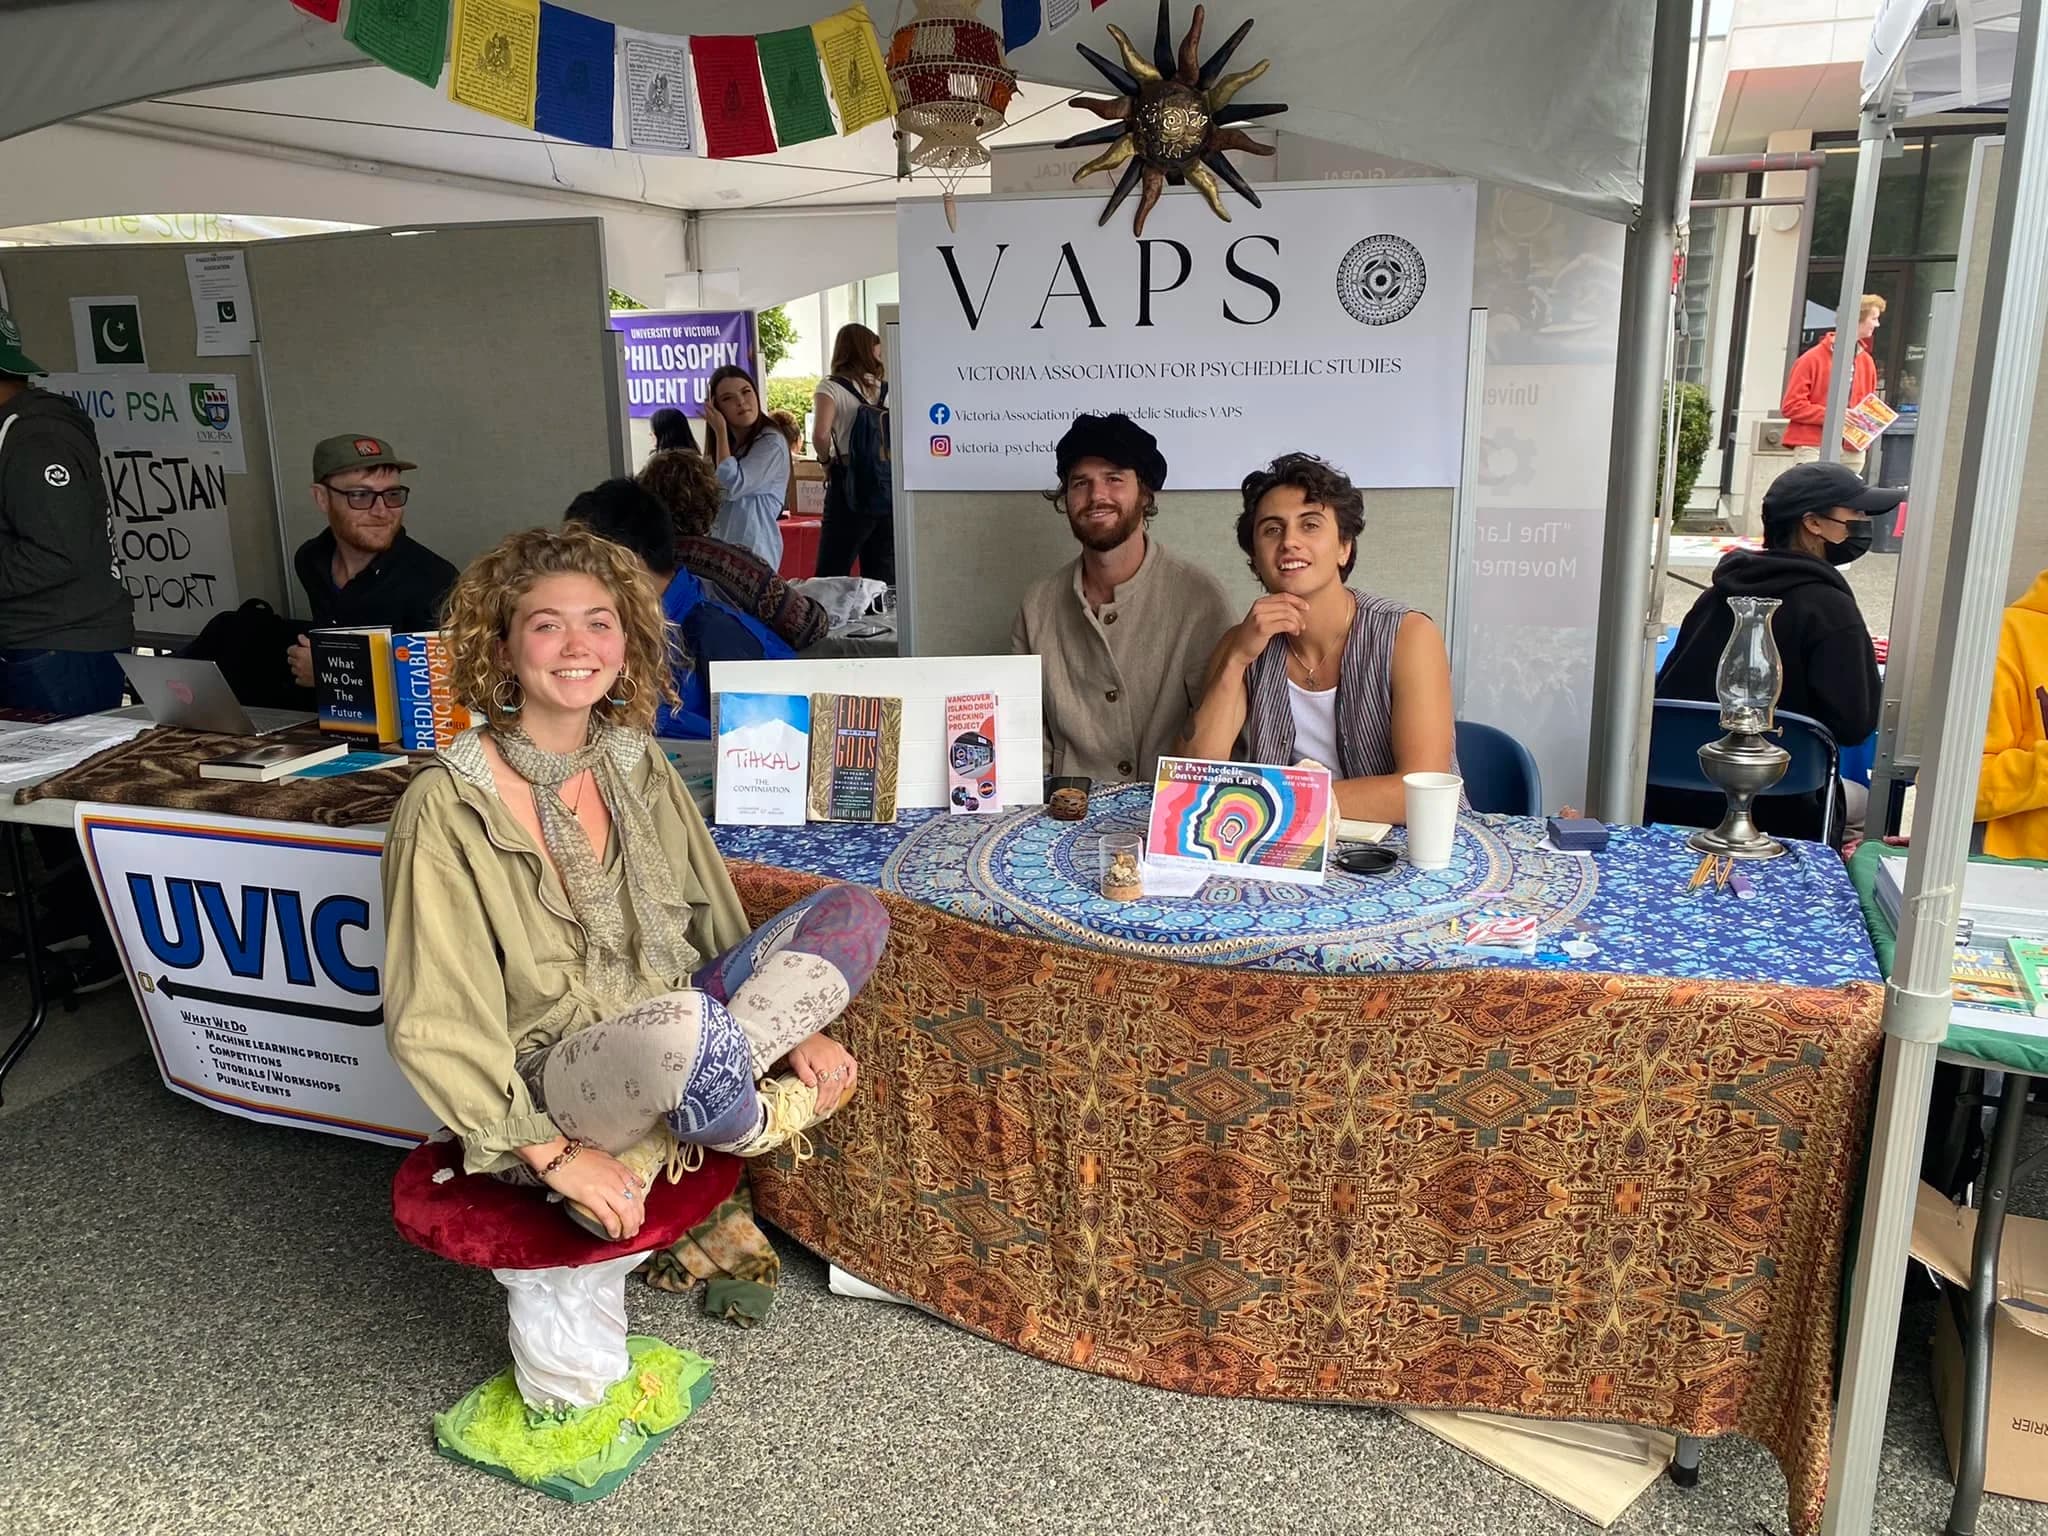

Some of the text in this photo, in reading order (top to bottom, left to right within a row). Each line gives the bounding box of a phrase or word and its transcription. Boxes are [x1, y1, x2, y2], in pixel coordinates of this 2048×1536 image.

[936, 235, 1281, 330] VAPS
[630, 325, 721, 339] UNIVERSITY OF VICTORIA
[957, 357, 1402, 383] VICTORIA ASSOCIATION FOR PSYCHEDELIC STUDIES
[126, 392, 179, 422] PSA
[955, 409, 1001, 422] Victoria
[1003, 408, 1070, 421] Association
[1164, 406, 1208, 419] Studies
[1209, 406, 1243, 419] VAPS
[328, 656, 355, 669] What
[321, 672, 364, 686] We Owe
[334, 689, 354, 702] The
[406, 635, 436, 751] PREDICTABLY
[947, 693, 991, 704] VANCOUVER
[330, 705, 363, 719] Future
[838, 695, 879, 730] FOOD
[948, 702, 995, 713] ISLAND DRUG
[948, 712, 985, 722] CHECKING
[948, 721, 981, 731] PROJECT
[835, 735, 876, 769] GODS
[1185, 763, 1244, 776] Psychedelic
[1169, 771, 1234, 784] Conversation
[733, 785, 791, 793] CONTINUATION
[125, 872, 380, 996] UVIC
[208, 1044, 283, 1068] COMPETITIONS
[252, 1040, 307, 1058] LEARNING
[307, 1049, 360, 1067] PROJECTS
